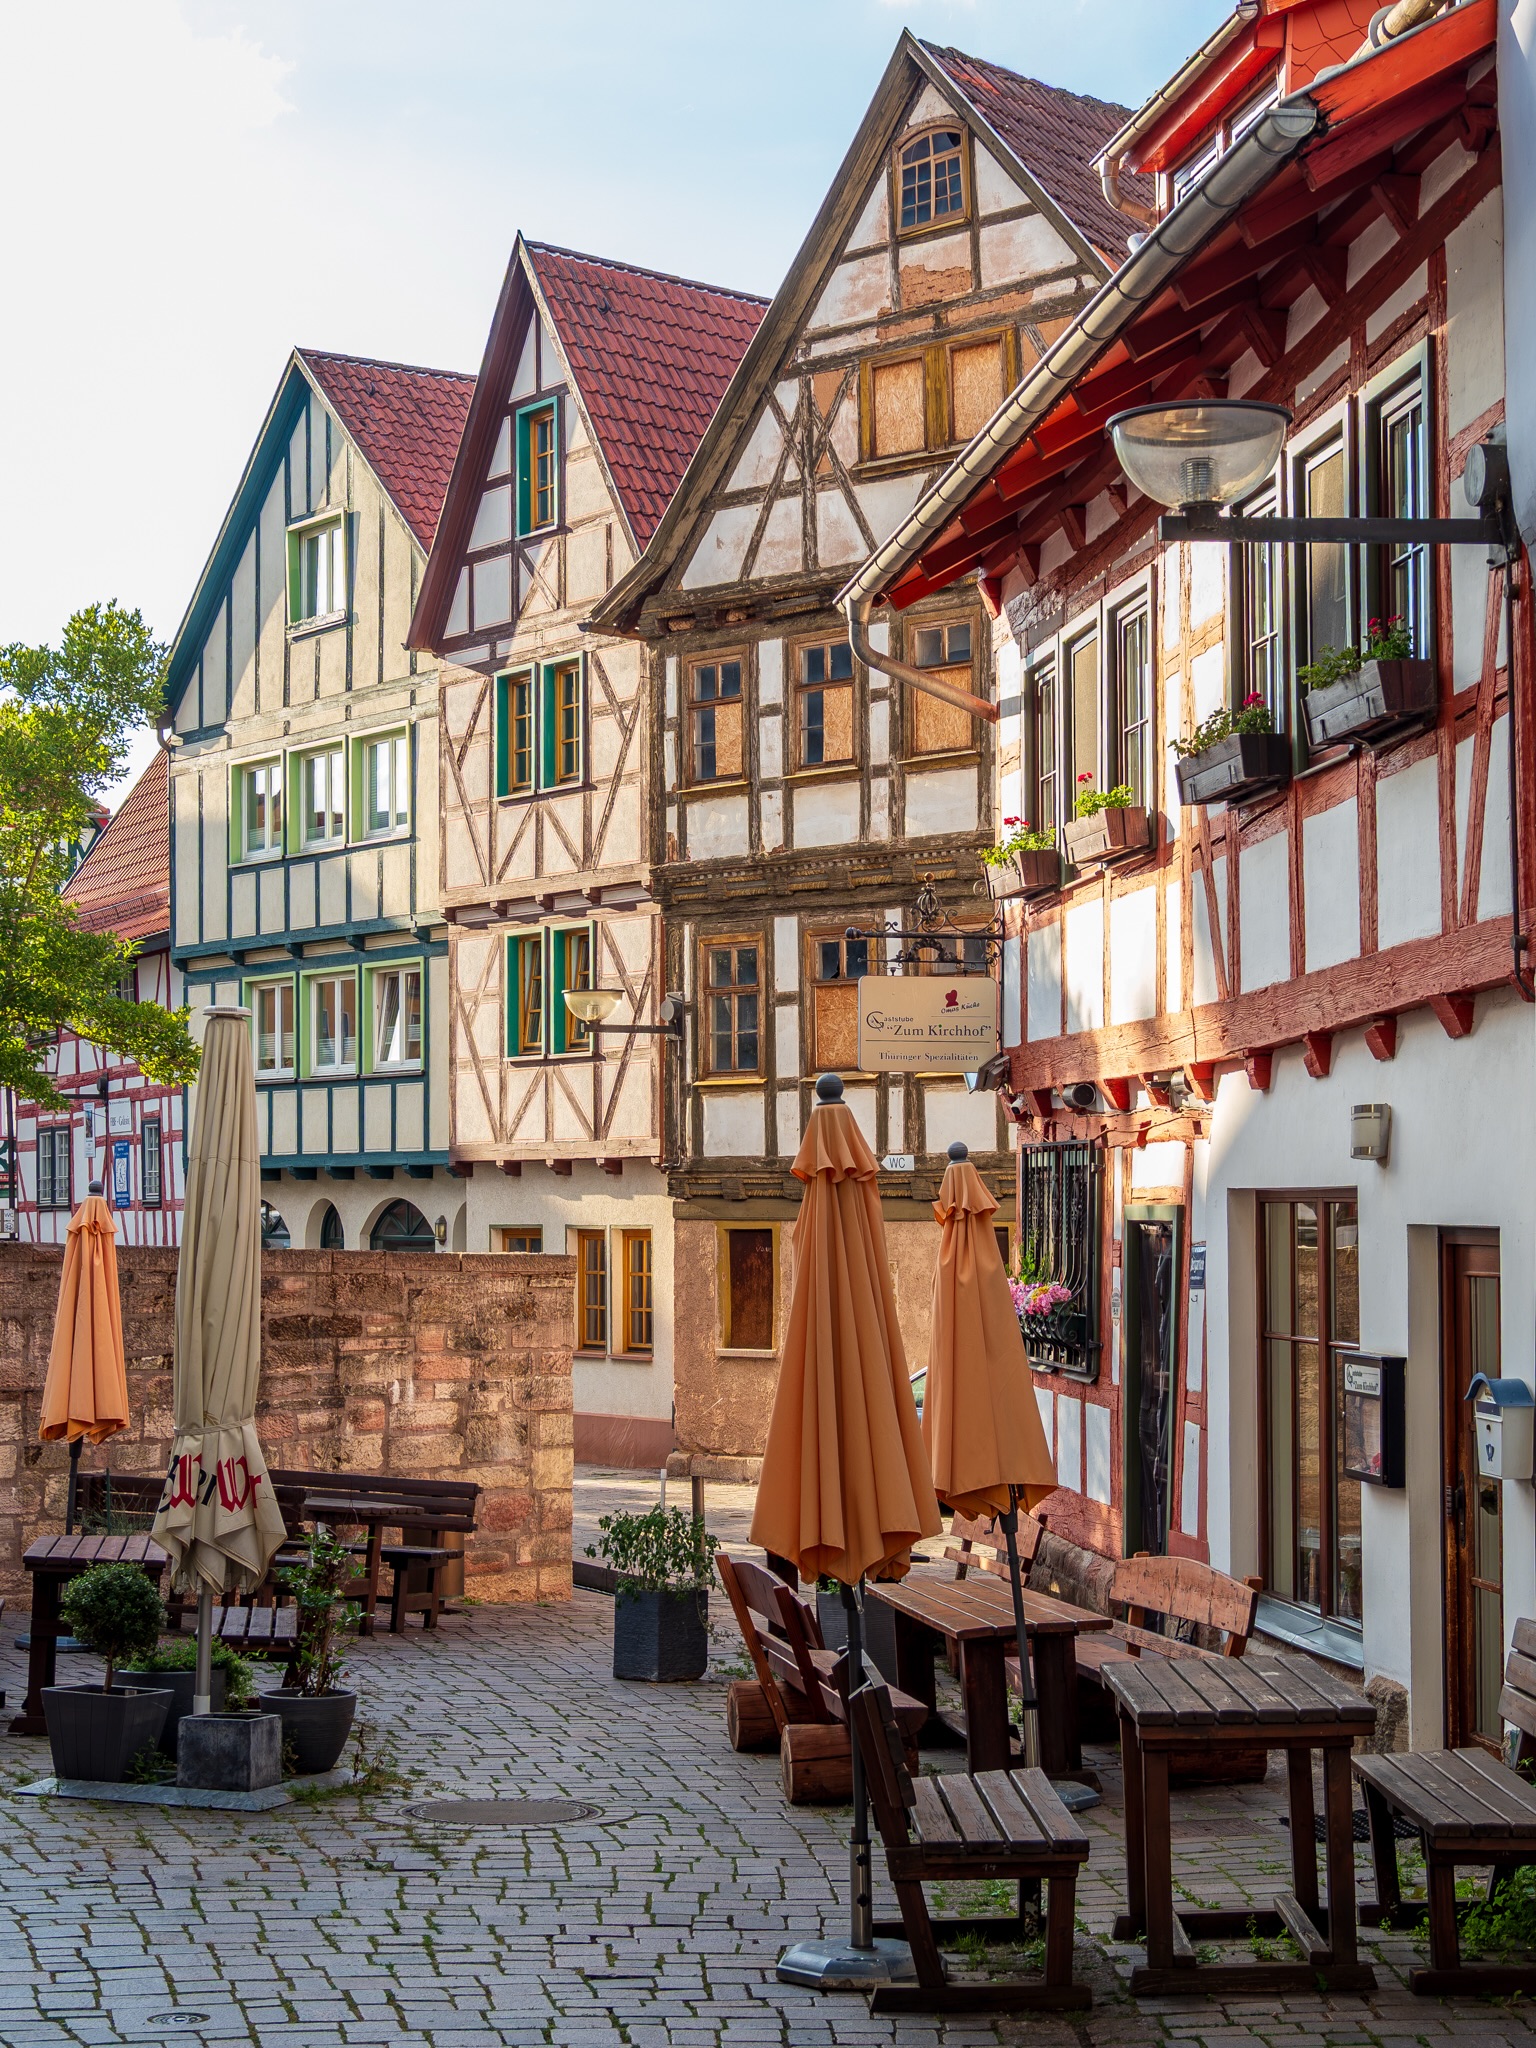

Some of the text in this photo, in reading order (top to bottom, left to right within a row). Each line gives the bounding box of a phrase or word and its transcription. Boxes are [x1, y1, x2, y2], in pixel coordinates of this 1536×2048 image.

[879, 1052, 979, 1063] Thüringer Spezialitäten
[889, 1157, 906, 1169] WC
